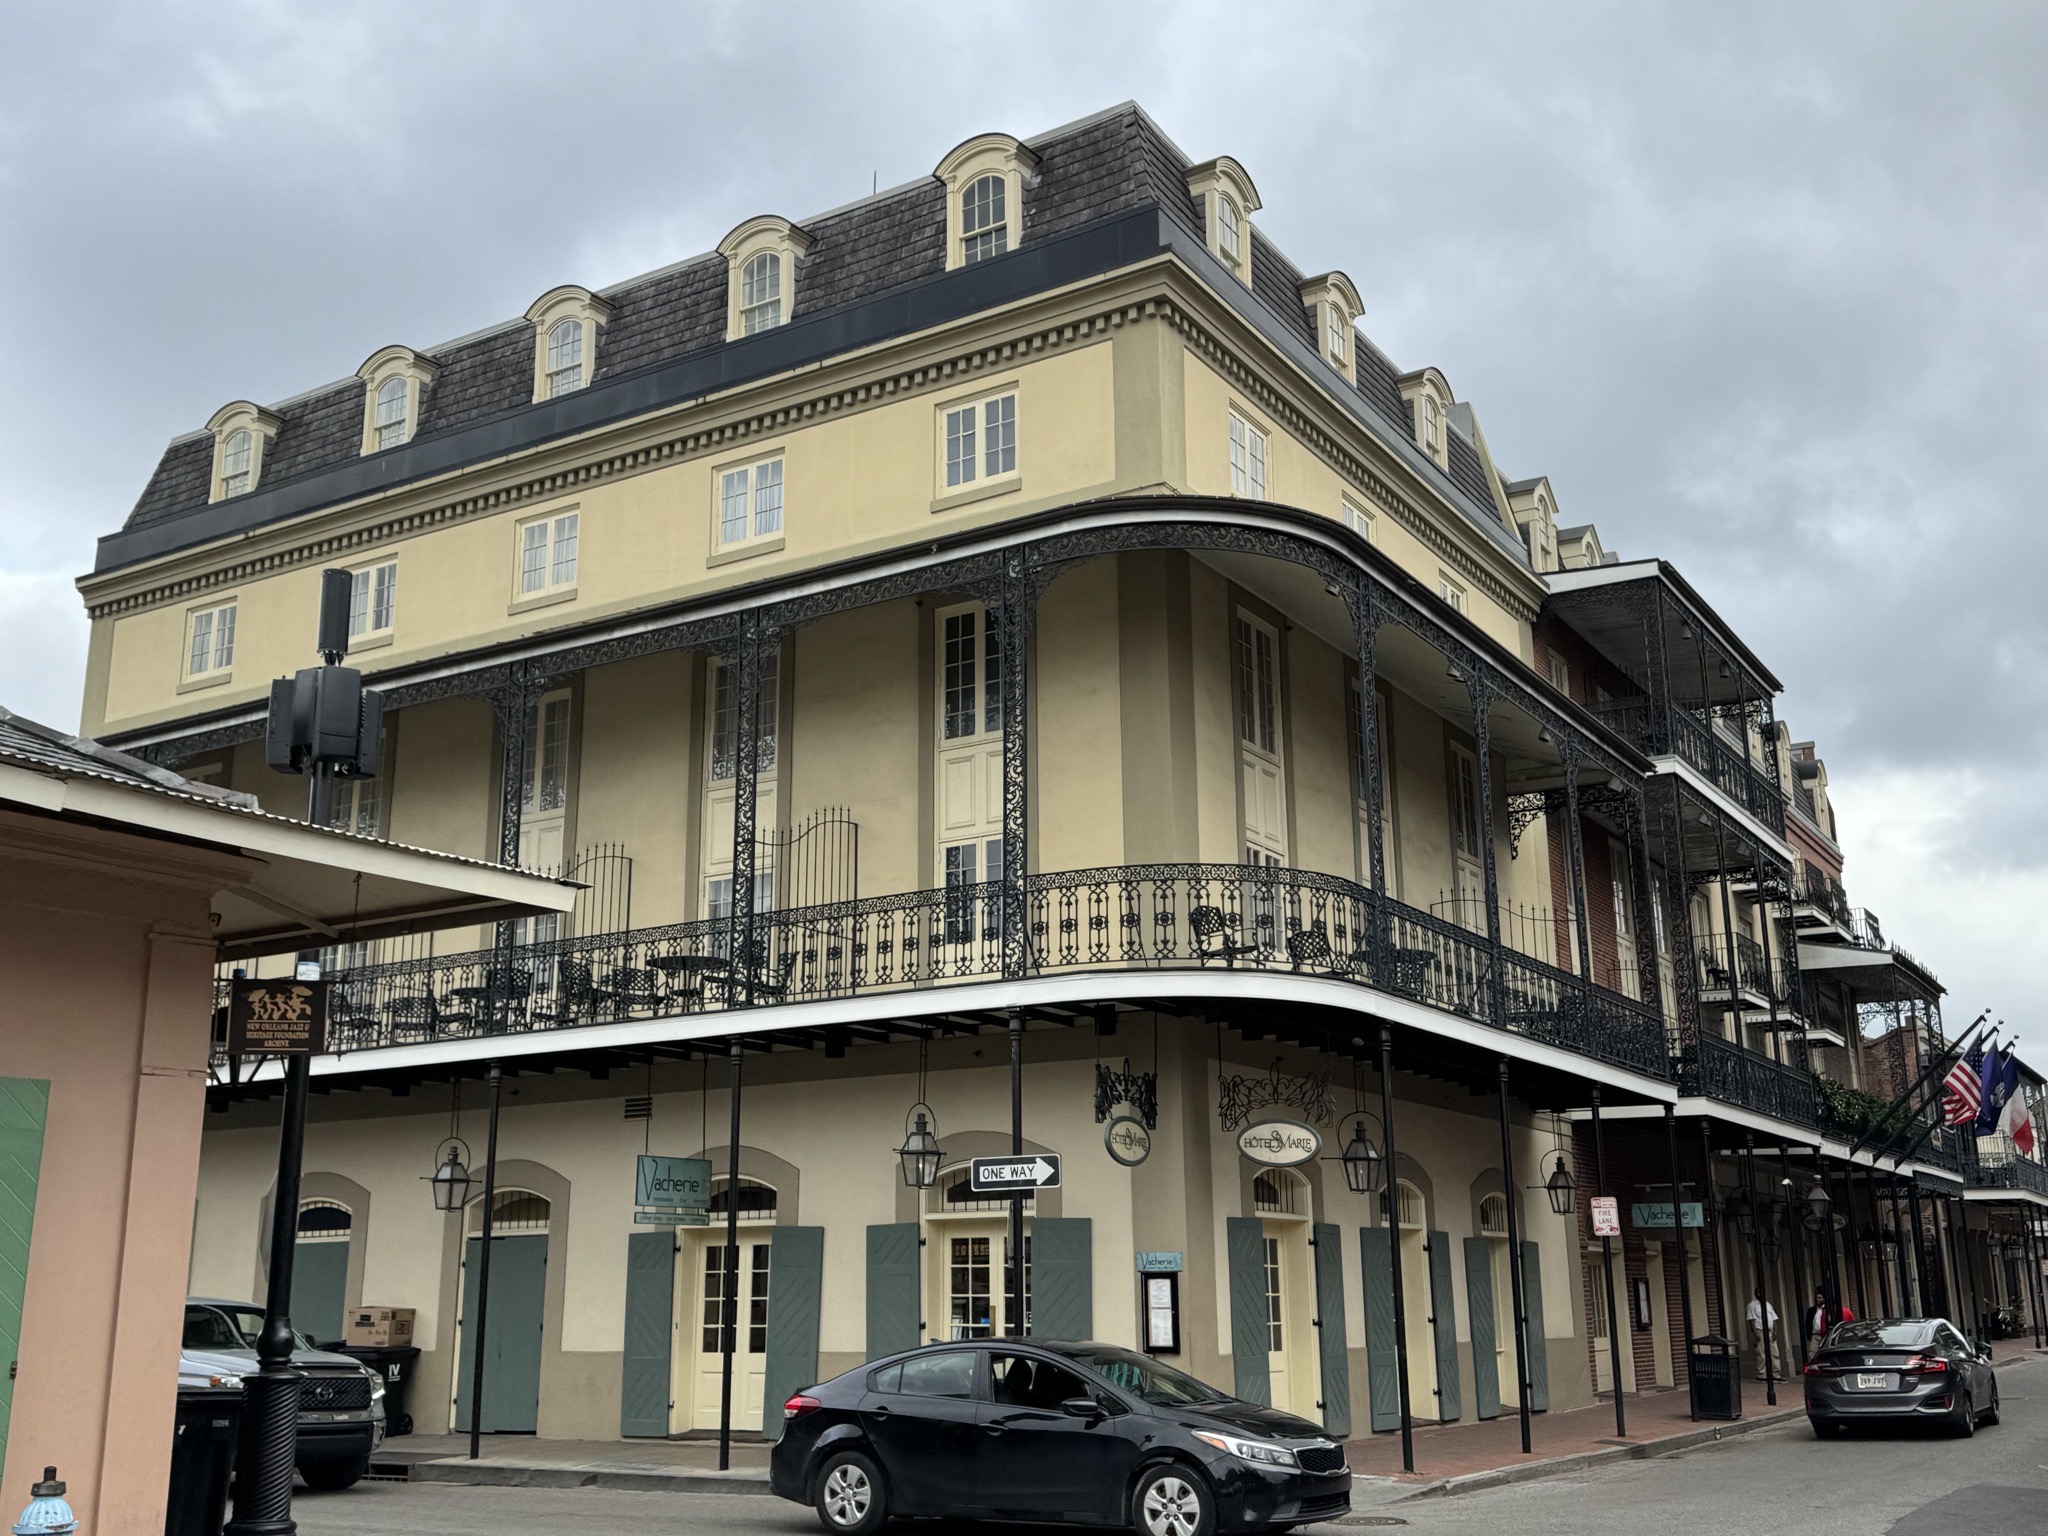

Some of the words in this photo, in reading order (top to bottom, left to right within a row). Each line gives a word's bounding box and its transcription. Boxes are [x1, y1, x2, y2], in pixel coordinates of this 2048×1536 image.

[246, 1031, 273, 1039] HERITAGE
[261, 1023, 288, 1031] ORLEANS
[1278, 1134, 1312, 1152] MARIE
[641, 1158, 699, 1201] Vacherie
[982, 1167, 1005, 1180] ONE
[1010, 1165, 1035, 1178] WAY
[1638, 1205, 1690, 1226] Vachee
[1140, 1253, 1173, 1269] Vacherie
